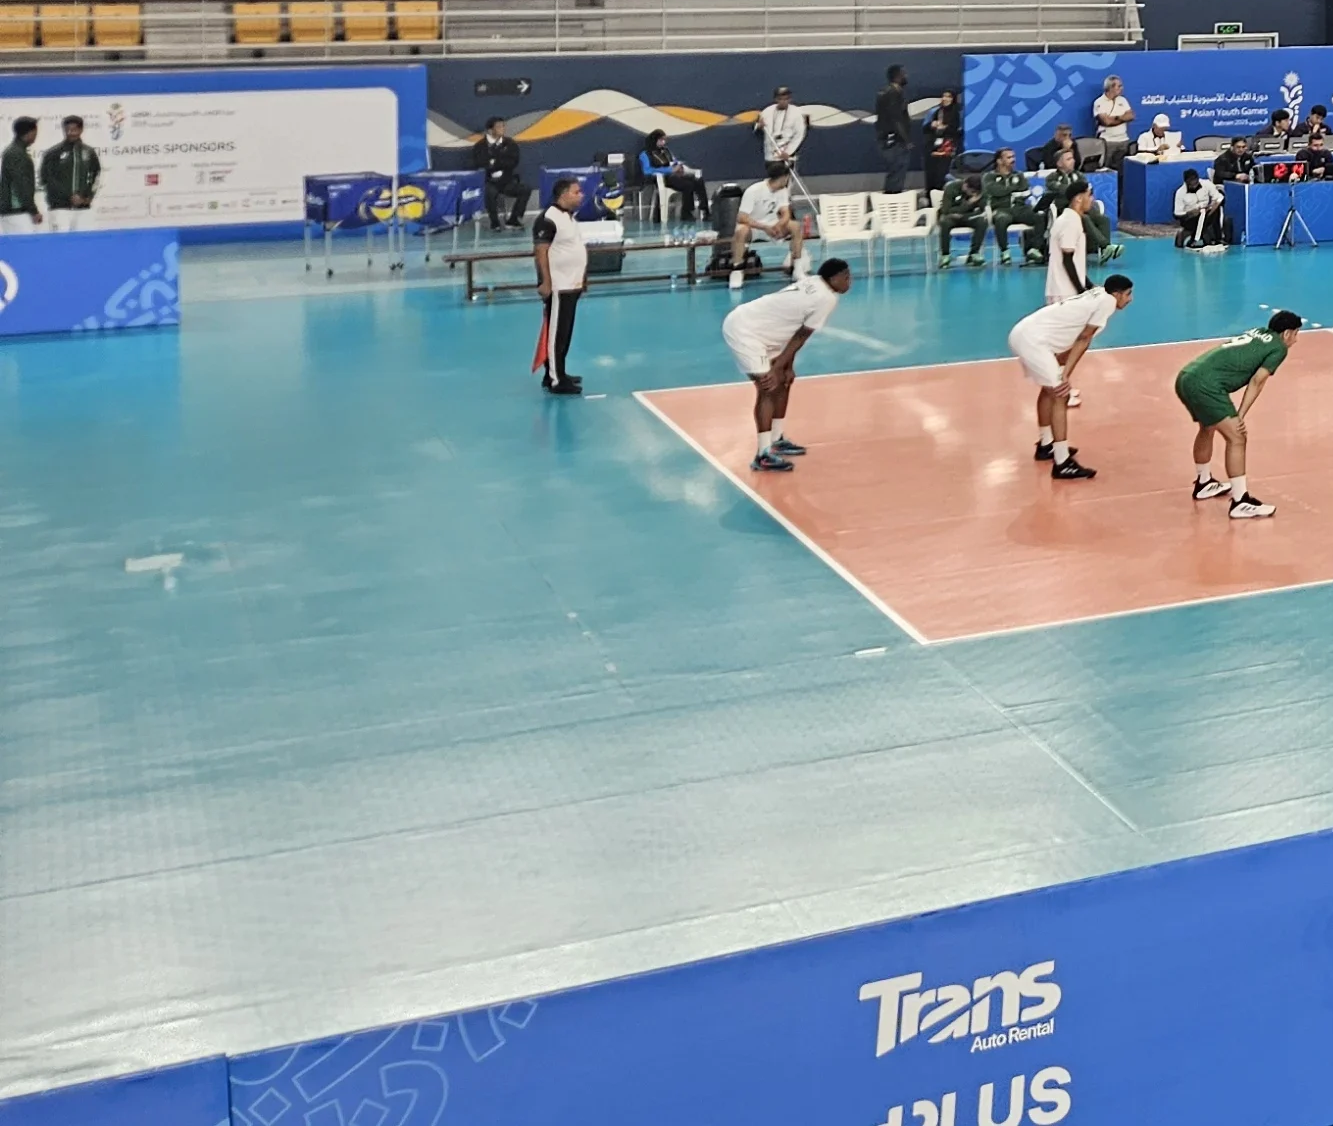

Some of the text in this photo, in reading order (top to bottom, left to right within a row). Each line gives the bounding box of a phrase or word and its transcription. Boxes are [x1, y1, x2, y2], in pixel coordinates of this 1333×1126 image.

[1192, 108, 1215, 118] Asian
[1216, 107, 1240, 117] Youth
[1241, 106, 1268, 116] Games
[112, 141, 237, 156] GAMES SPONSORS
[859, 959, 1062, 1058] Trans
[970, 1017, 1055, 1054] Auto Rental
